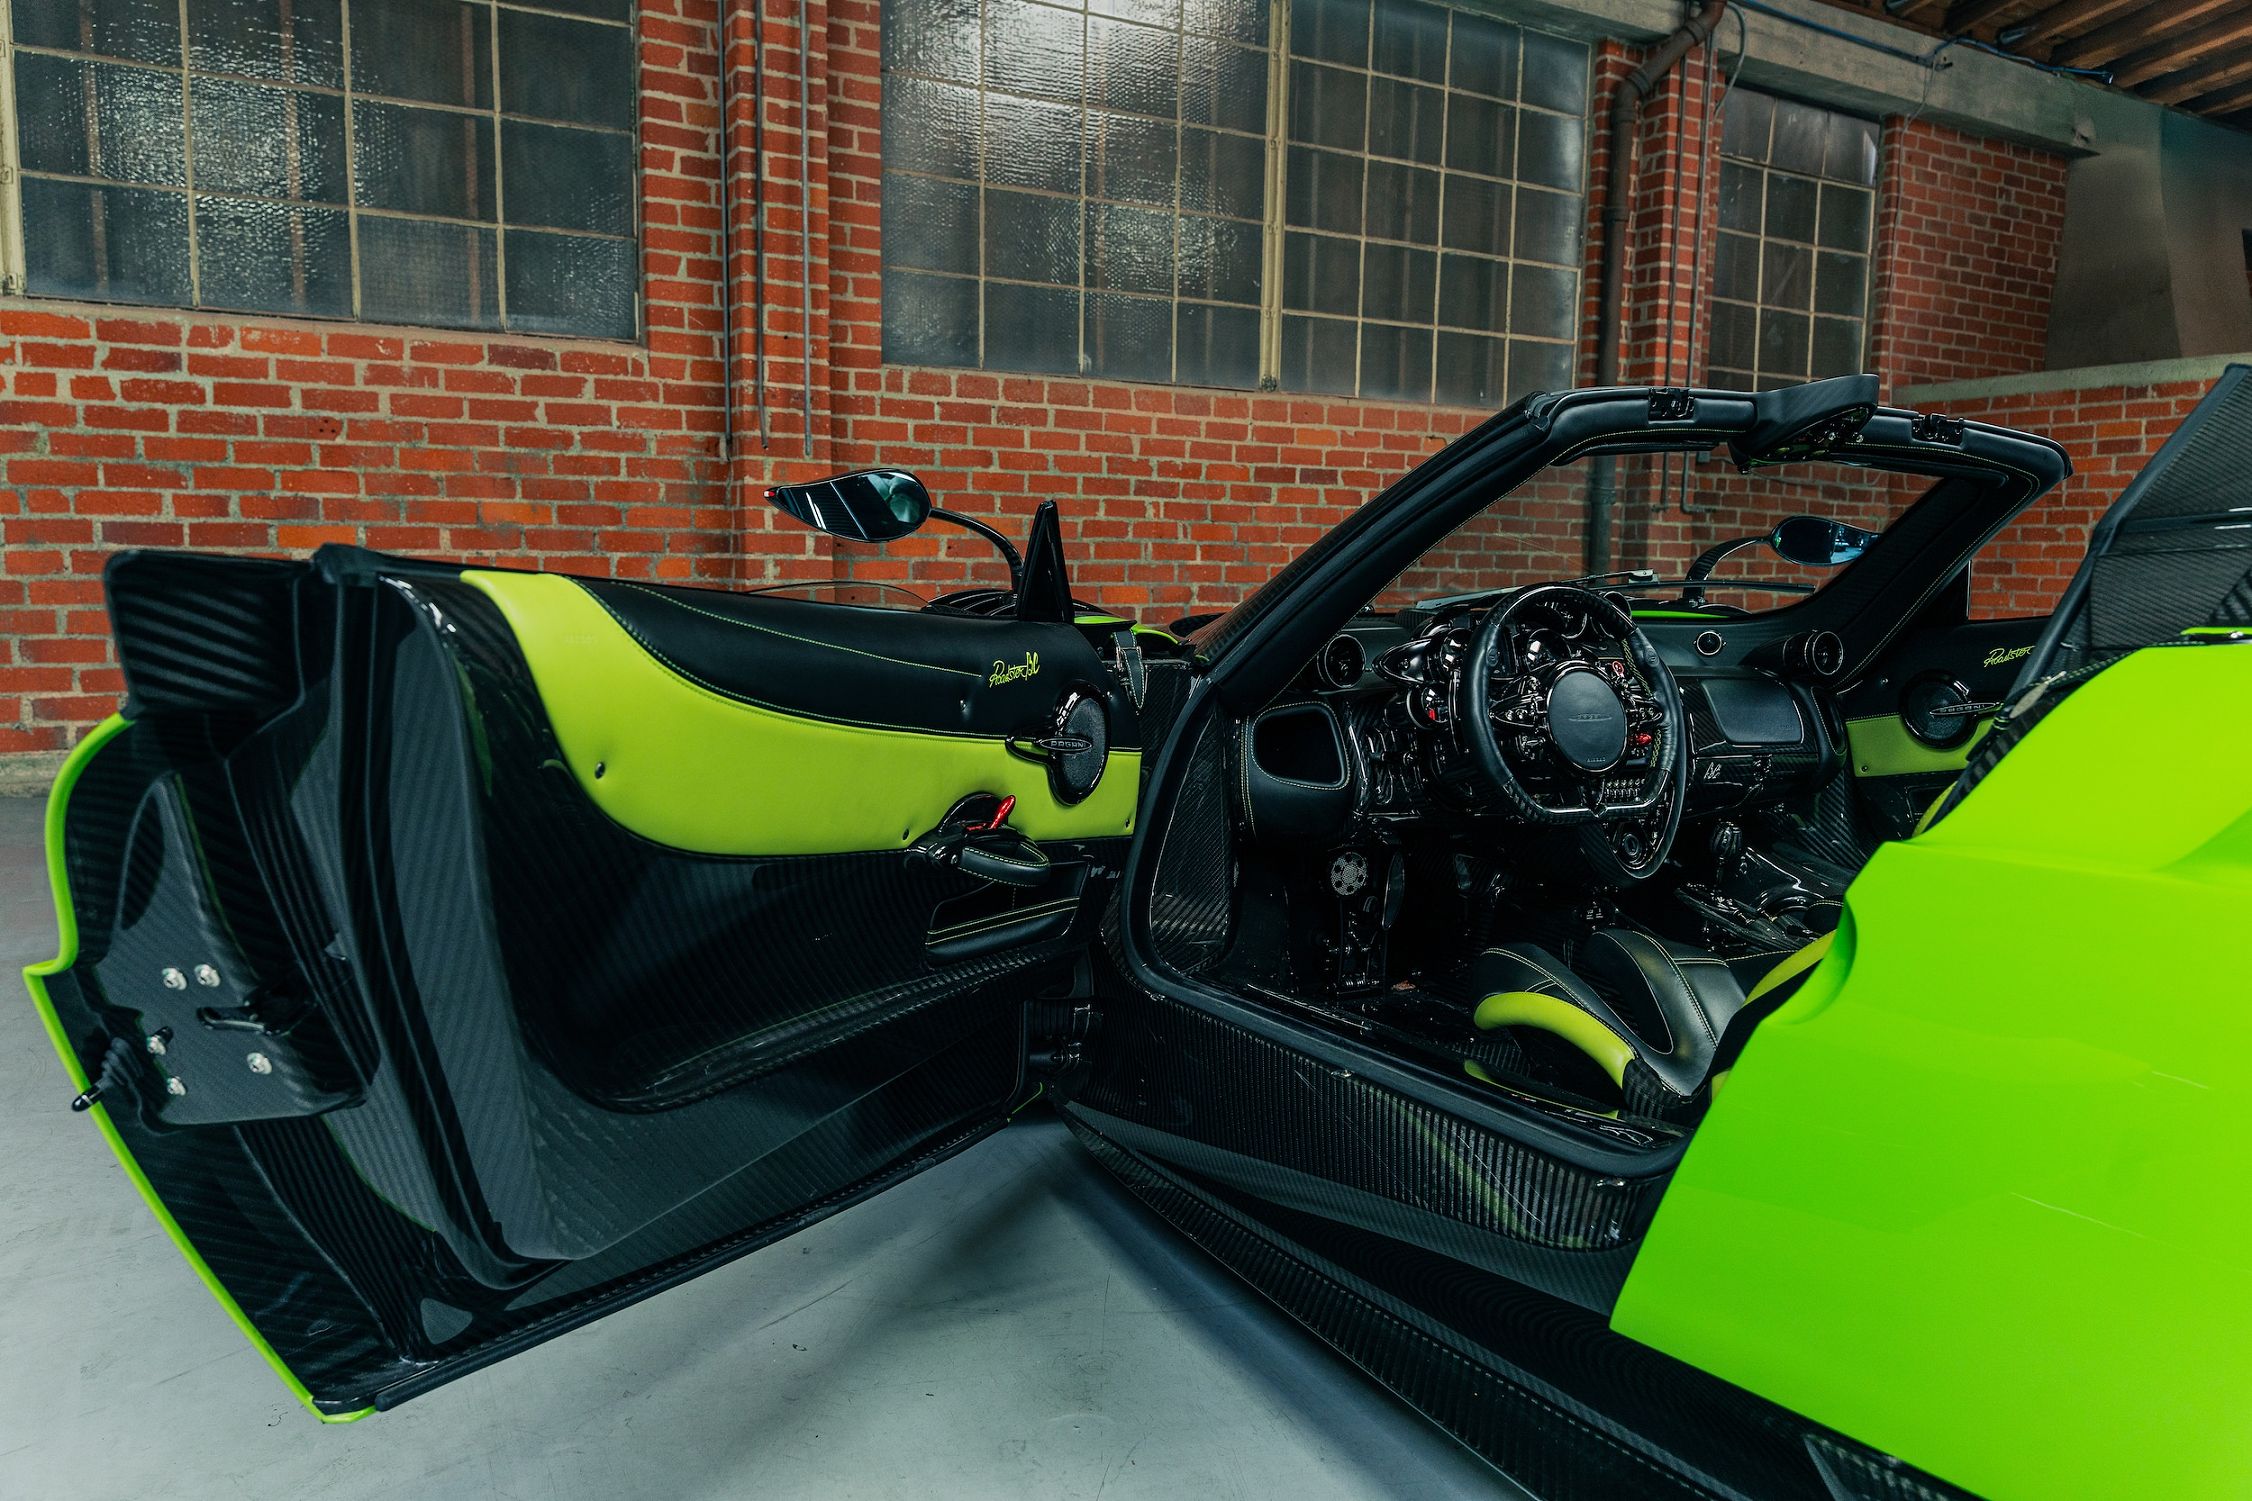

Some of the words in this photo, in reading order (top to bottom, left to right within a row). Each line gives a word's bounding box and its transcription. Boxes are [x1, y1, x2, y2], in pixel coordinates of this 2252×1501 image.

[1983, 645, 2036, 668] Roadster
[989, 660, 1027, 688] Roadster
[1050, 740, 1087, 748] PAGANI
